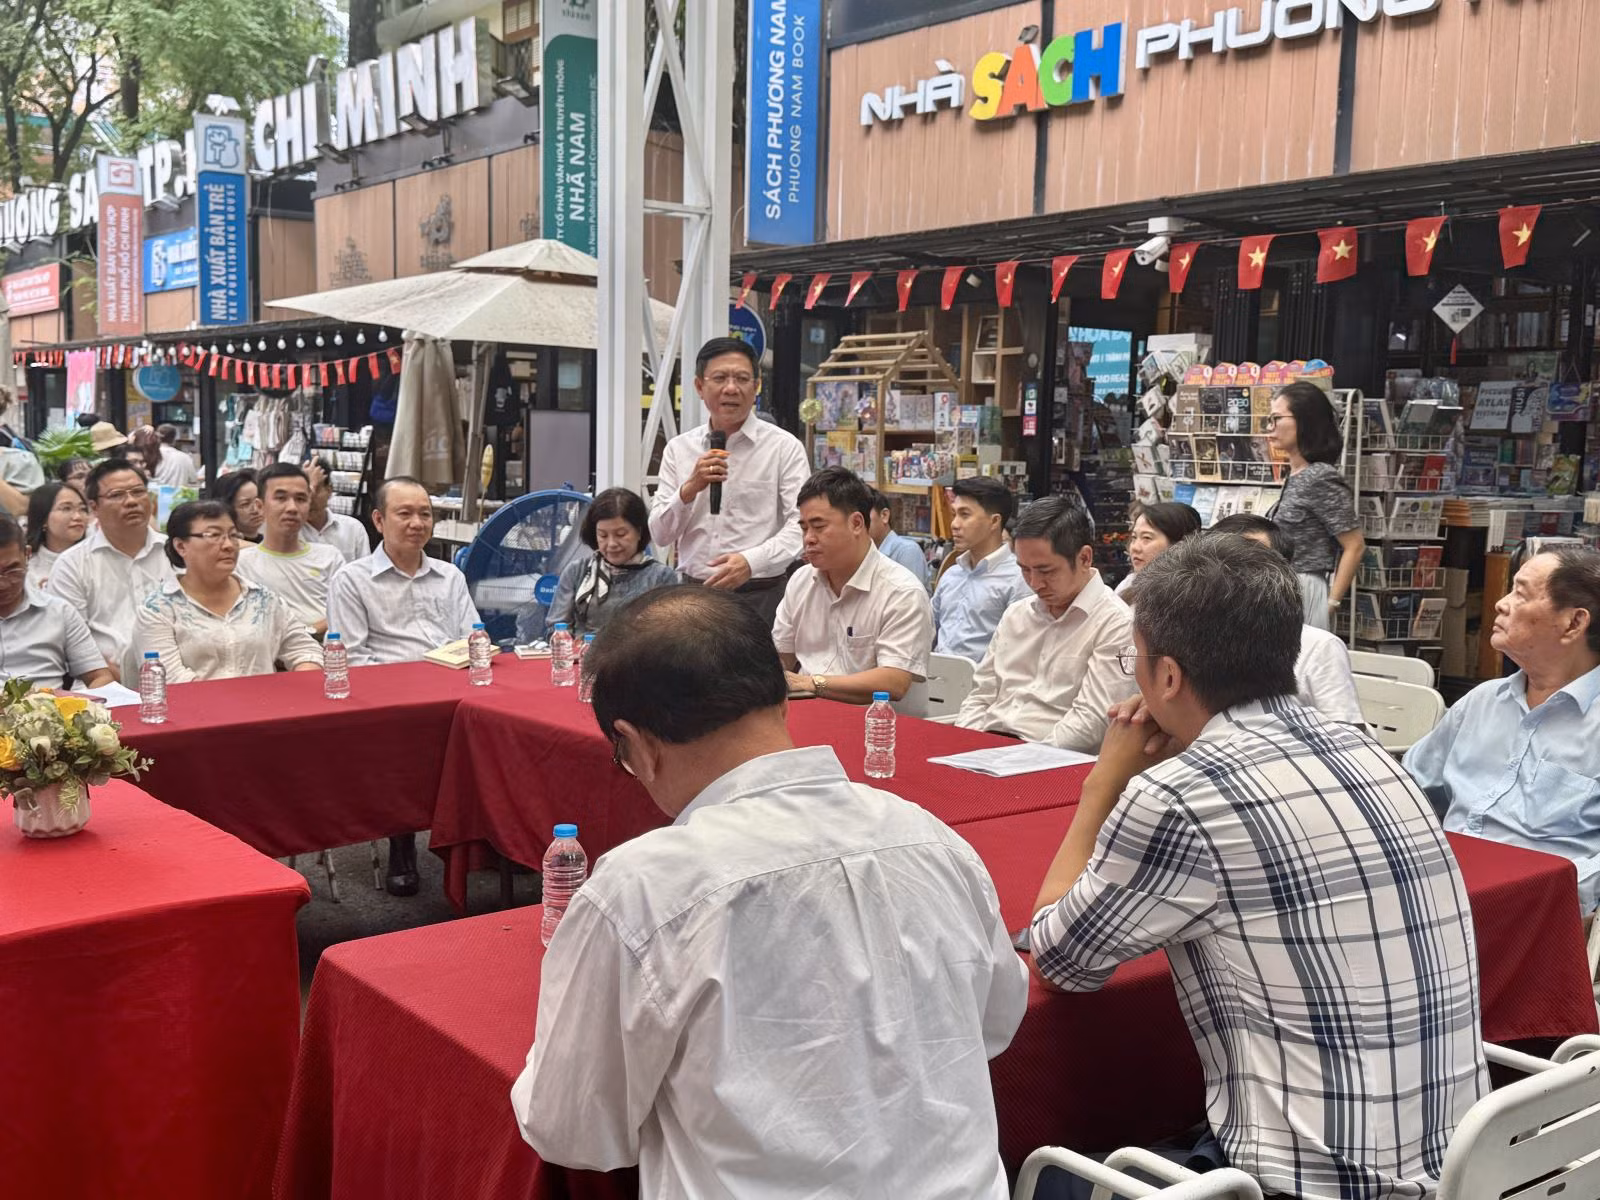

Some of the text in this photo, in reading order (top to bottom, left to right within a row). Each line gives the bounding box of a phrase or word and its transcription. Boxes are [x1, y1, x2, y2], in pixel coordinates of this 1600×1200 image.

[254, 54, 325, 171] CHÍ
[336, 16, 482, 151] MINH
[766, 50, 785, 149] PHƯƠNG
[788, 14, 805, 203] PHUONG NAM BOOK
[860, 59, 966, 126] NHÀ
[968, 22, 1129, 121] SÁCH
[226, 184, 236, 221] HOUSE
[566, 112, 585, 221] NHÃ NAM
[762, 153, 782, 220] SÁCH
[203, 183, 227, 320] NHÀ XUẤT BẢN TRẺ
[228, 301, 238, 321] THE
